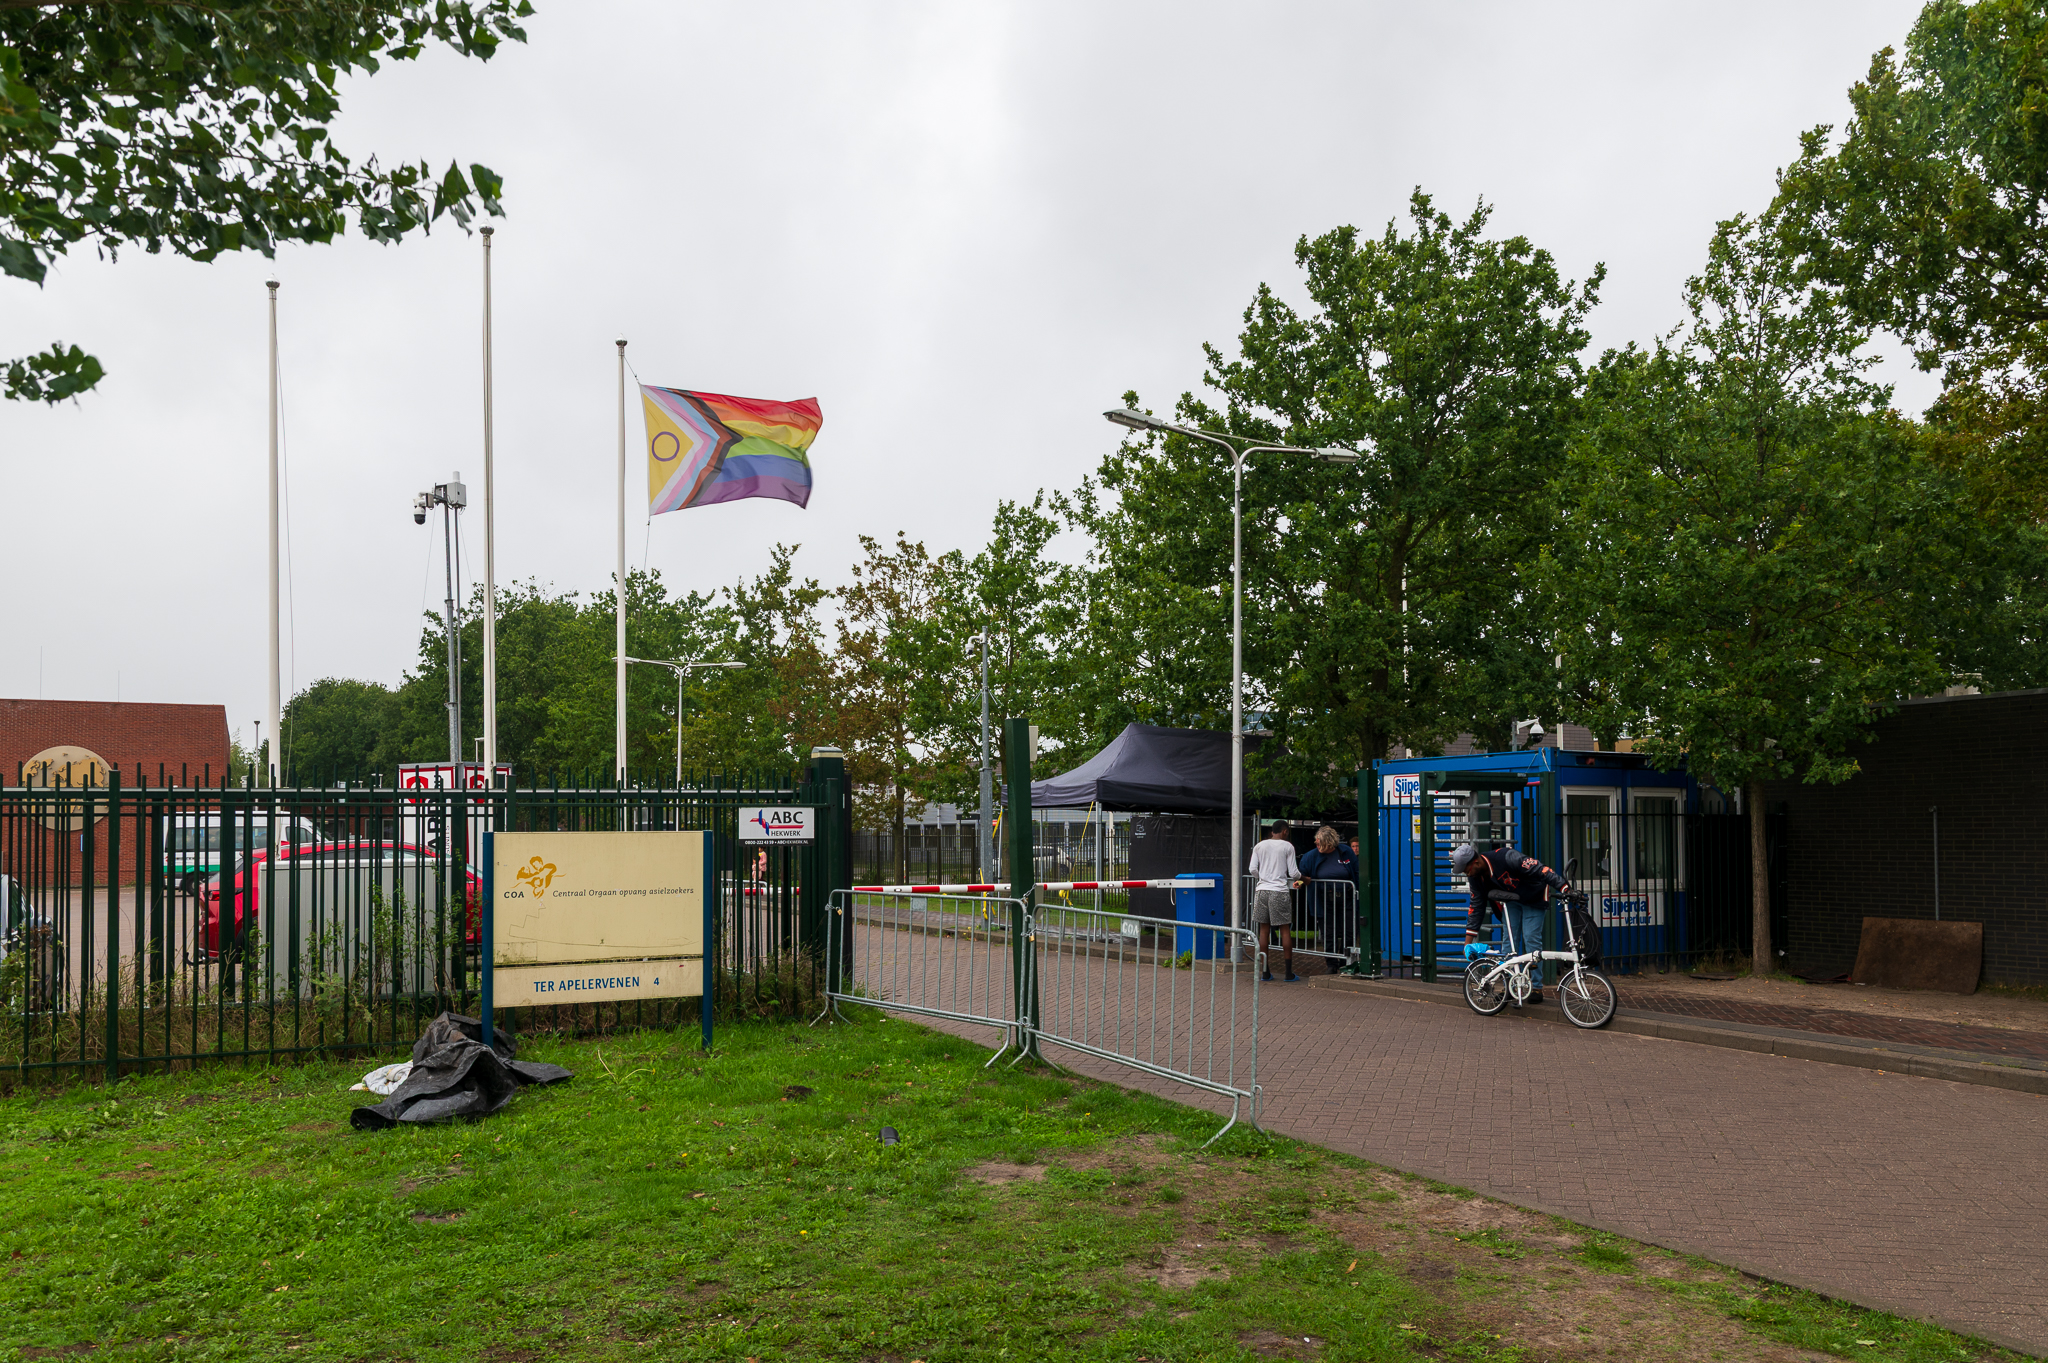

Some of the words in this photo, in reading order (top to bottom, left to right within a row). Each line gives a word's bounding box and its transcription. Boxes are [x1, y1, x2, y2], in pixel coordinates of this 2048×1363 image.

[1395, 778, 1420, 794] Sijpe
[770, 811, 804, 824] ABC
[503, 891, 525, 899] COA
[552, 889, 587, 898] Centraal
[588, 889, 617, 898] Orgaan
[619, 888, 647, 897] opvang
[648, 886, 694, 895] asielzoekers
[533, 981, 555, 993] TER
[558, 976, 640, 992] APELERVENEN
[653, 977, 660, 986] 4
